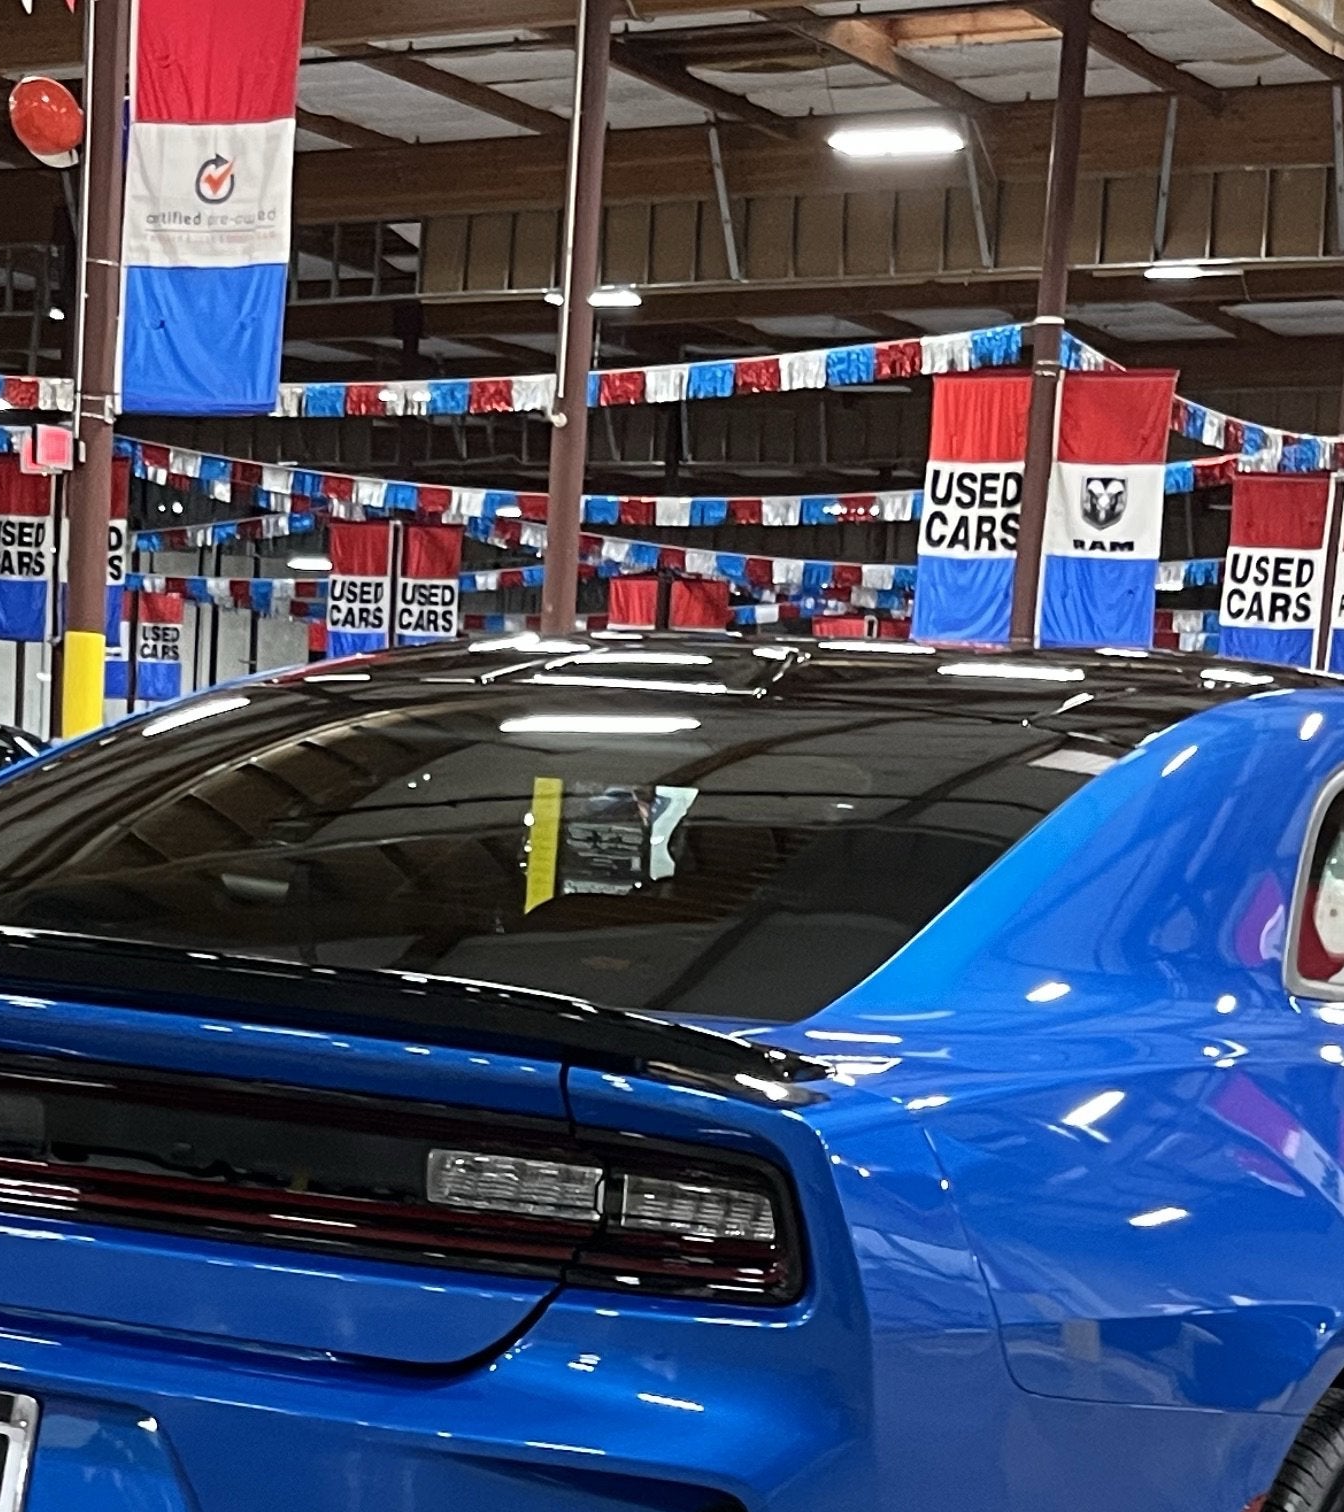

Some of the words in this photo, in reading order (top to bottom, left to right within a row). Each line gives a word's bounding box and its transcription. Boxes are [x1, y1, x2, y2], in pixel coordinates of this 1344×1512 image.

[929, 469, 1023, 510] USED
[924, 510, 1021, 551] CARS
[1072, 539, 1135, 552] RAM
[1230, 553, 1315, 589] USED
[330, 580, 384, 604] USED
[401, 582, 455, 607] USED
[329, 604, 384, 629] CARS
[1226, 588, 1312, 623] CARS
[398, 608, 454, 633] CARS
[141, 625, 180, 643] USED
